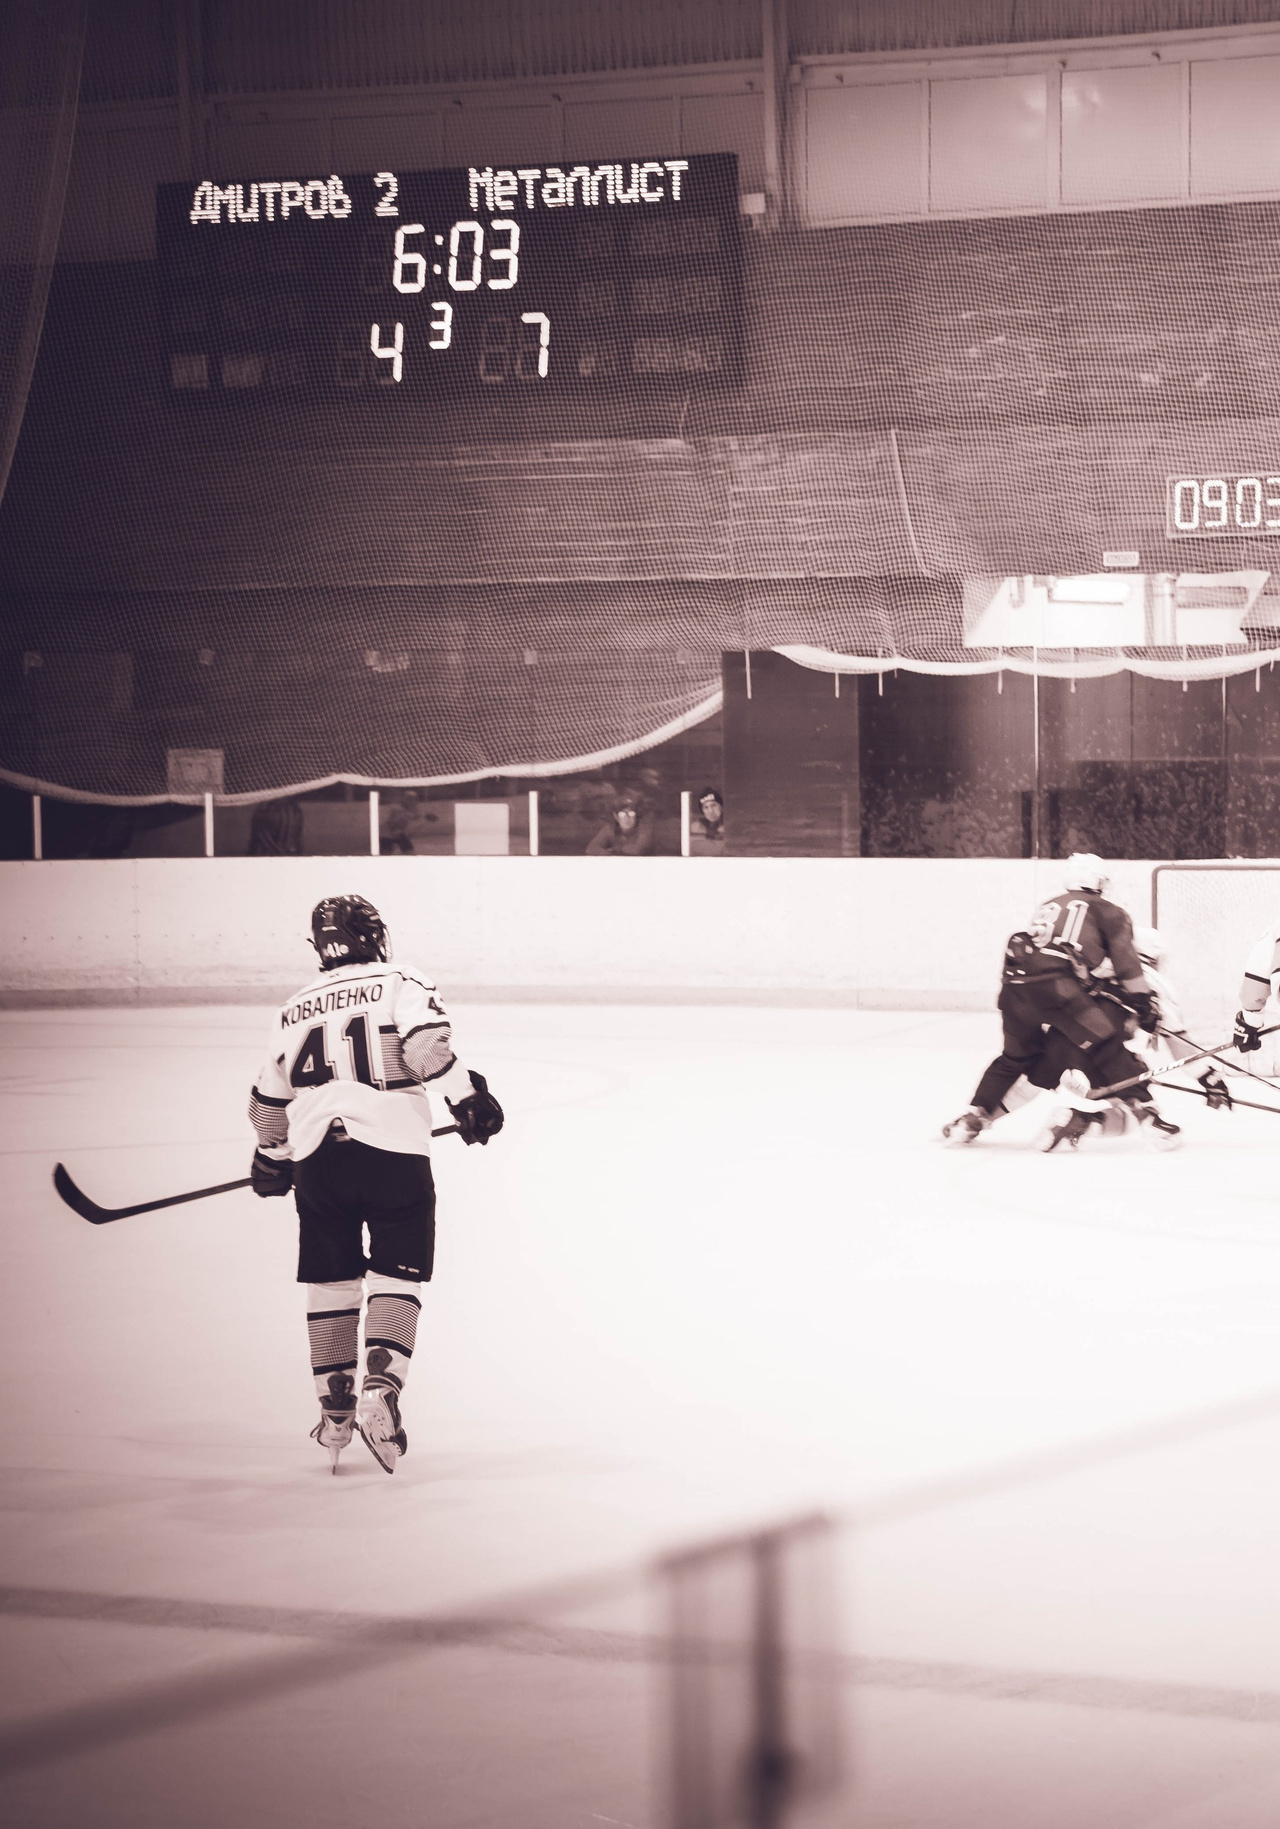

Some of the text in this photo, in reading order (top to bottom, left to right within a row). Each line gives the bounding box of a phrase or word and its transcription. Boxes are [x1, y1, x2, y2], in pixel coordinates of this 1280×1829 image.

[373, 171, 400, 217] 2
[468, 160, 689, 212] Металлист
[392, 219, 521, 294] 6:03
[370, 322, 404, 383] 4
[428, 301, 454, 351] 3
[521, 311, 551, 379] 7
[281, 983, 384, 1030] КОВАЛЕНКО
[289, 1011, 387, 1091] 41
